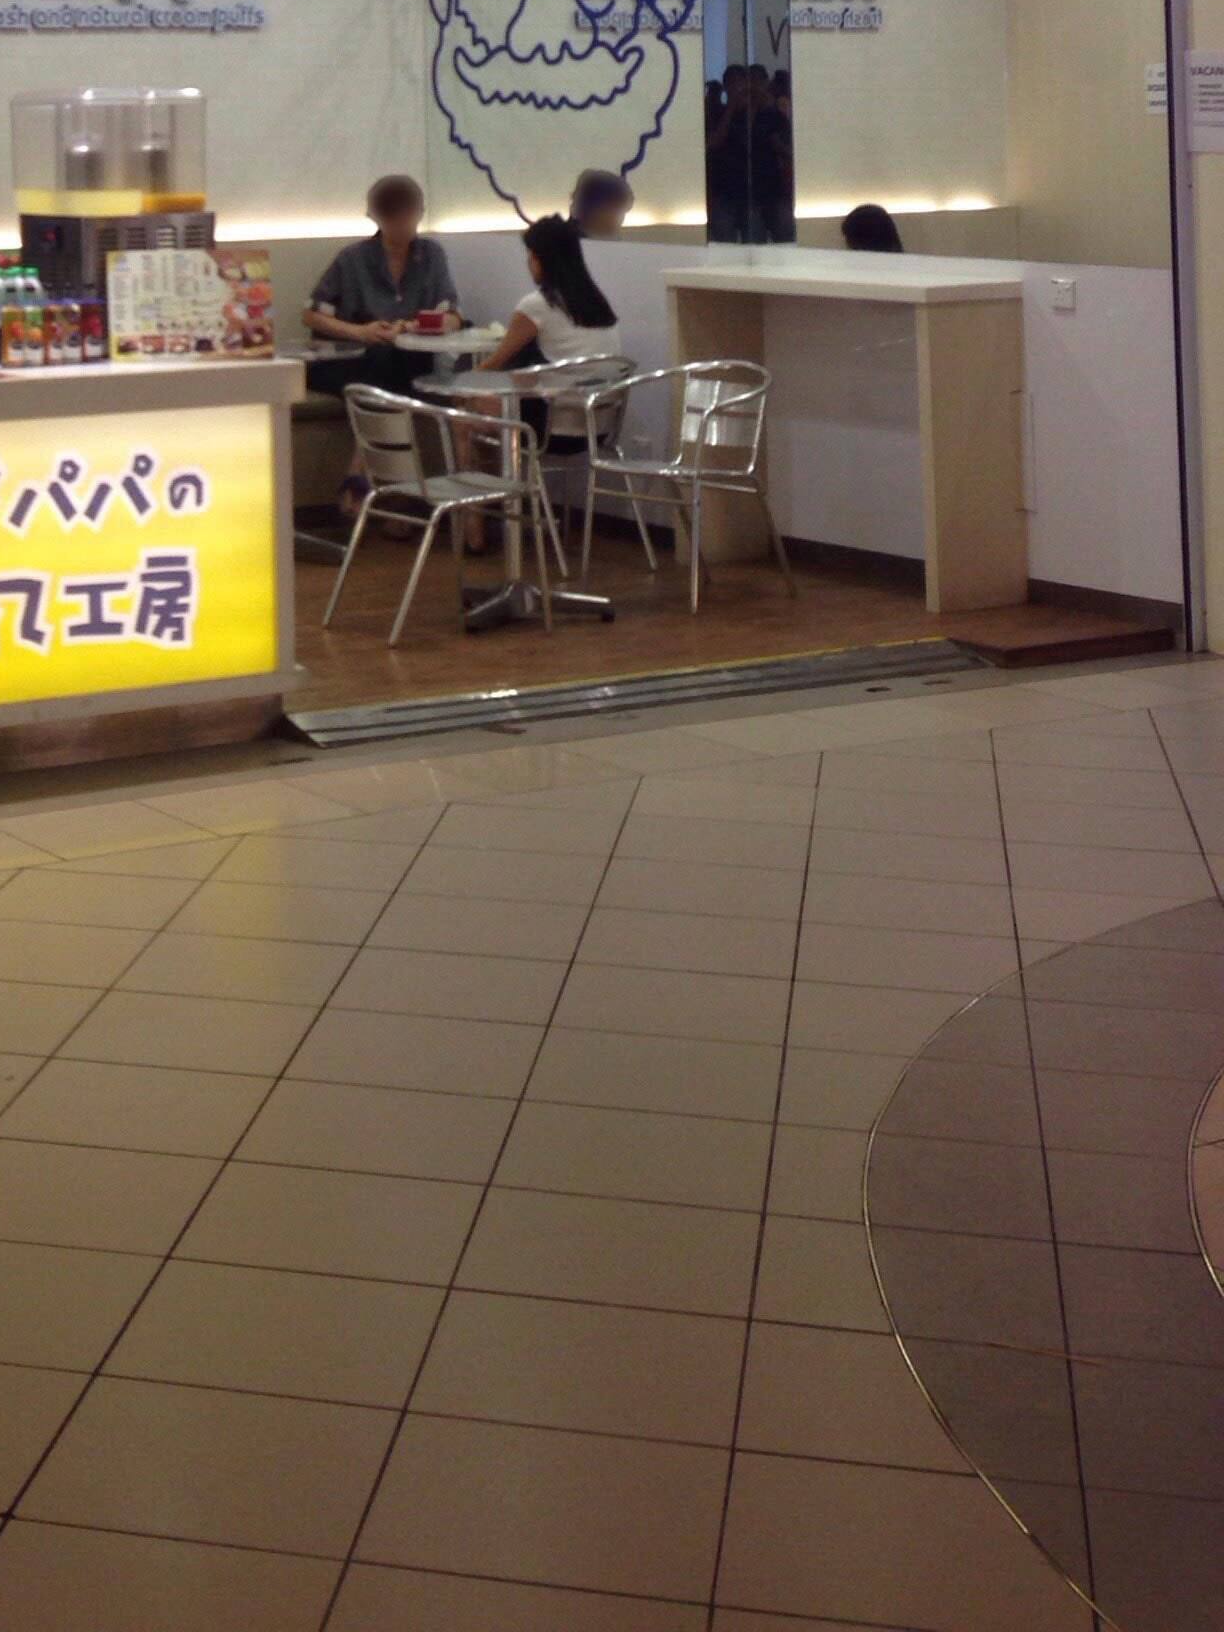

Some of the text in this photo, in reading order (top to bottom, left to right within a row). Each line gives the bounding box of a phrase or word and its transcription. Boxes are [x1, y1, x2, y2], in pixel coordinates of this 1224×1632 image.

[38, 5, 73, 25] and
[78, 6, 146, 26] natural
[216, 6, 264, 30] puffs
